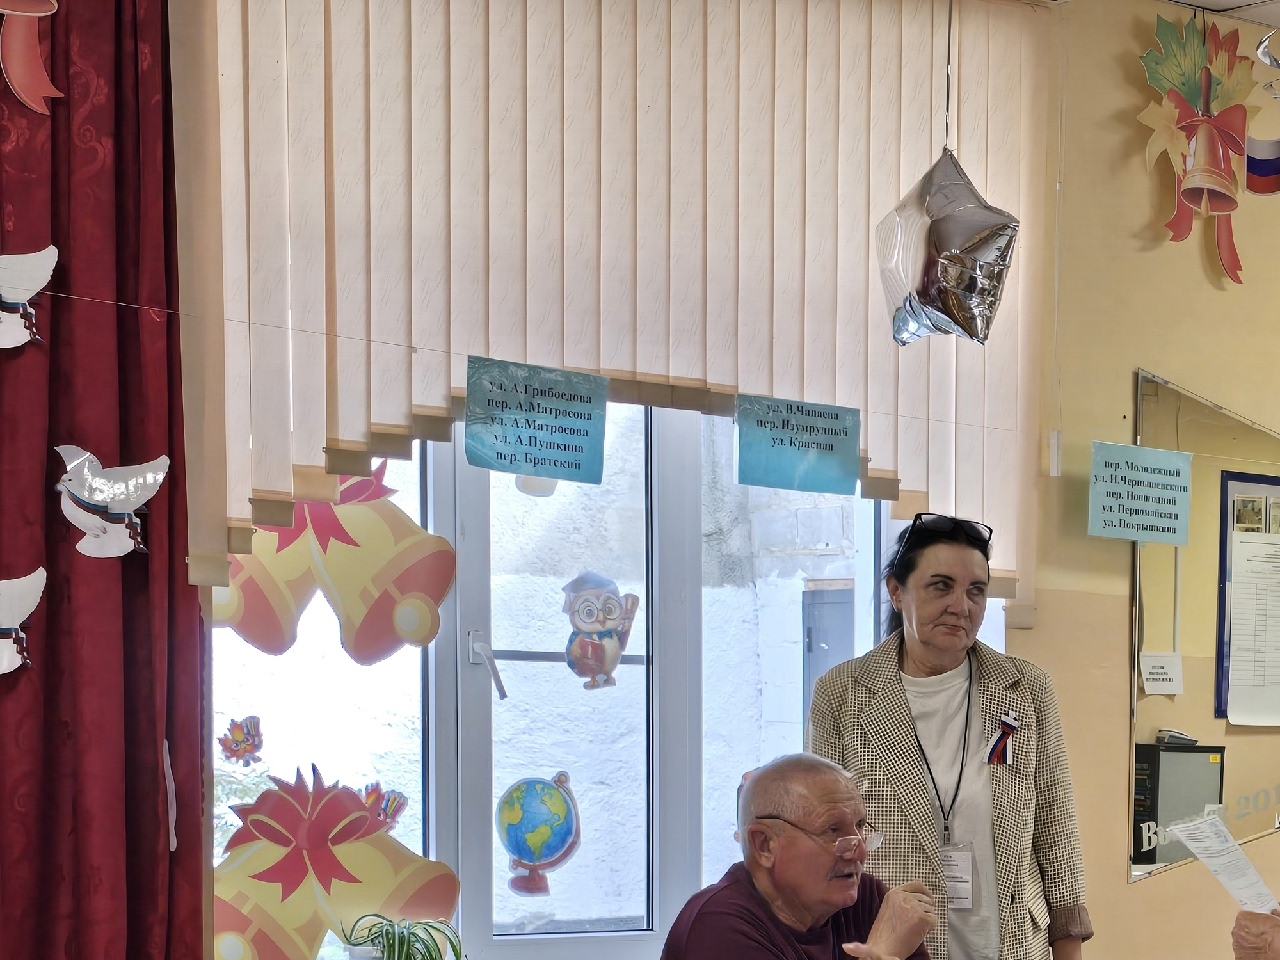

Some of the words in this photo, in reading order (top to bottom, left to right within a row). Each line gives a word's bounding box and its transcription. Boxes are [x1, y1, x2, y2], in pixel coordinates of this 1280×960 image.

[487, 398, 512, 412] пер.
[515, 400, 592, 420] А.Матросова
[786, 404, 839, 420] В.Чапаева
[490, 416, 507, 427] ул.
[511, 417, 589, 437] А.Матросова
[756, 419, 778, 431] пер.
[782, 419, 848, 437] Изумрудный
[493, 434, 511, 445] ул.
[515, 435, 584, 454] А.Пушкина
[771, 437, 786, 447] ул.
[789, 436, 834, 451] Красная
[496, 451, 520, 465] пер.
[524, 452, 581, 470] Братский
[1104, 460, 1122, 471] пер.
[1094, 474, 1107, 484] ул.
[1106, 490, 1124, 500] пер.
[1102, 504, 1115, 514] ул.
[1103, 519, 1116, 528] ул.
